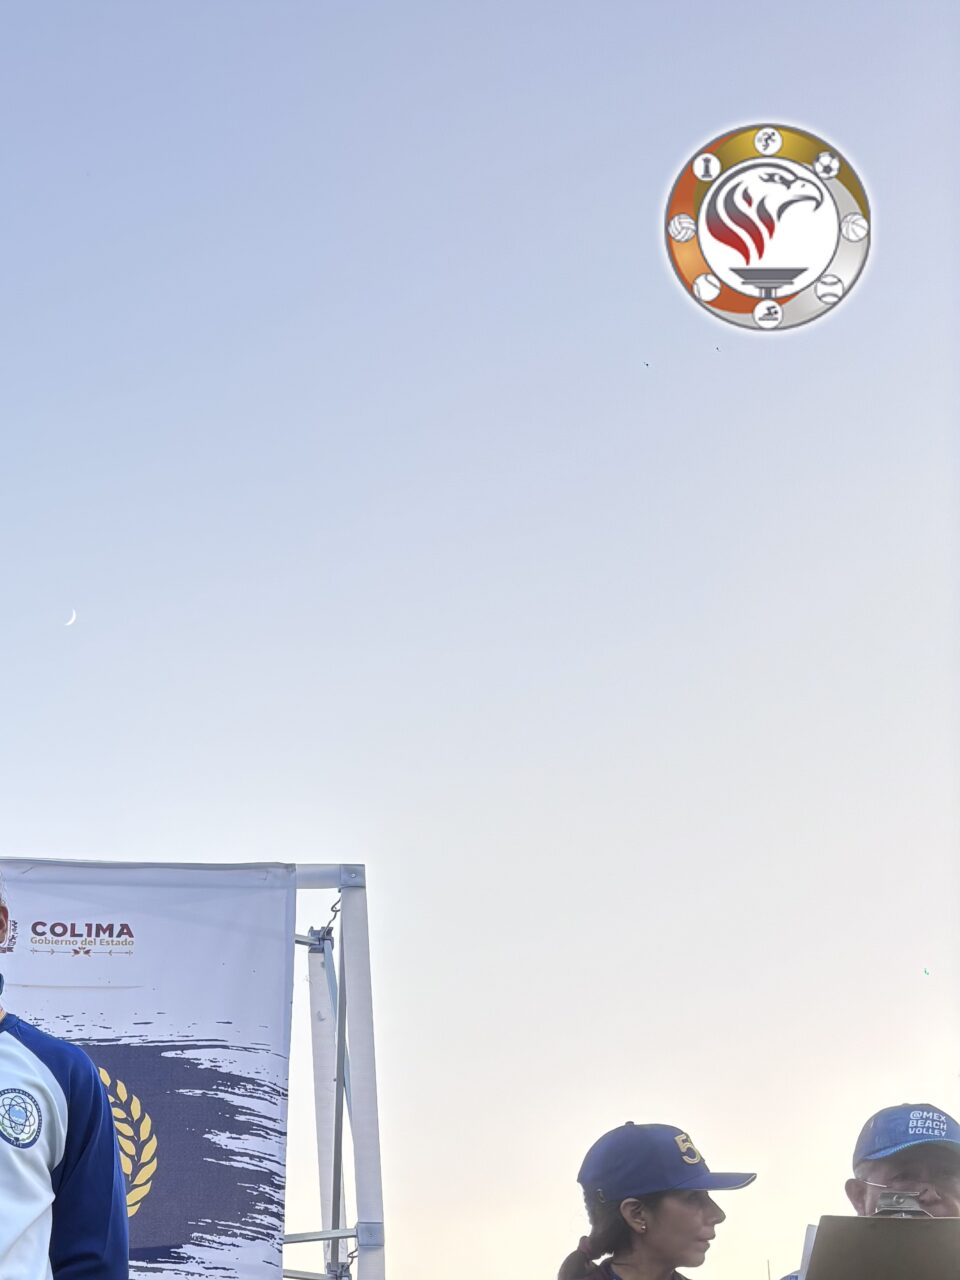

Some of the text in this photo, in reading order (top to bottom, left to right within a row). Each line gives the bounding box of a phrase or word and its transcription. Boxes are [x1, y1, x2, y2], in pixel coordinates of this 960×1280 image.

[30, 937, 135, 946] Gobierno del Estado
[910, 1110, 947, 1122] @MEX
[908, 1119, 947, 1131] BEACH
[908, 1127, 946, 1137] VOLLEY
